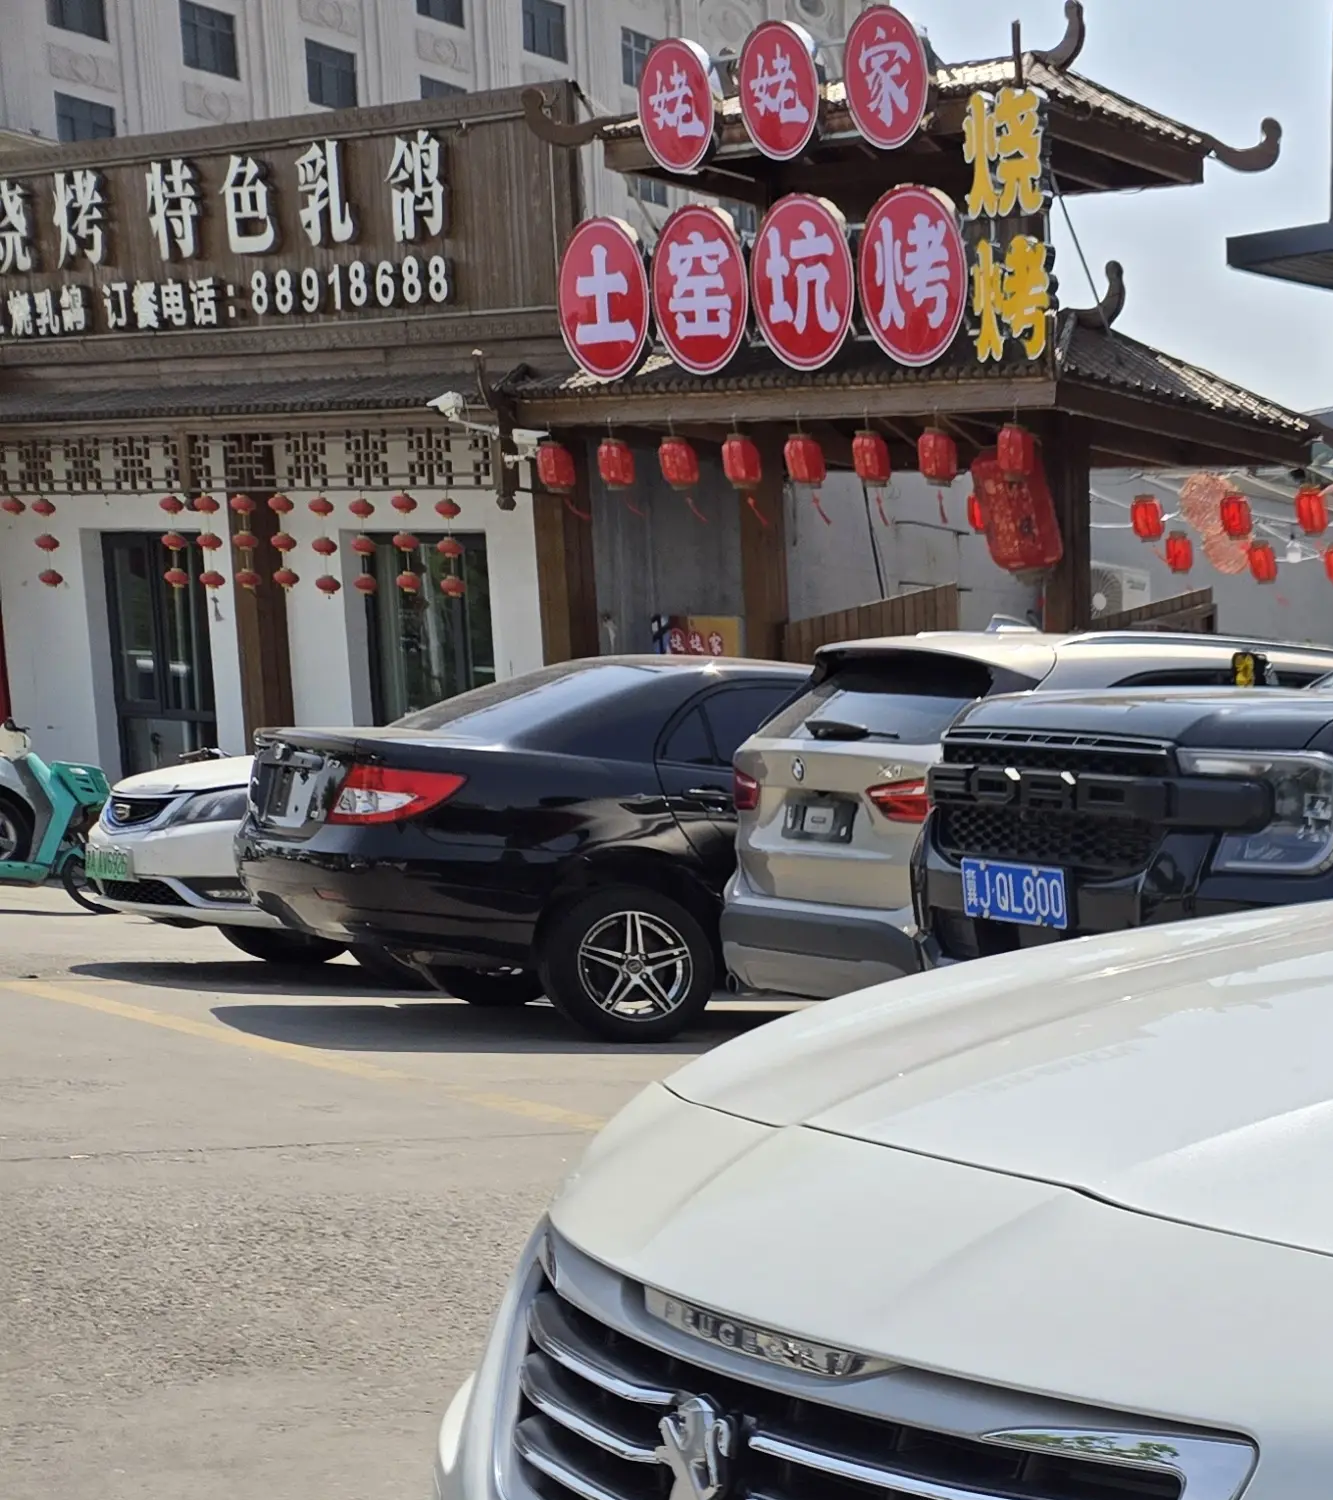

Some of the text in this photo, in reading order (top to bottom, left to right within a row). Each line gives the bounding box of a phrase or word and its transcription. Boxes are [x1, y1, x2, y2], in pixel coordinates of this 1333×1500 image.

[648, 27, 912, 139] 姥姥家
[145, 130, 445, 260] 特色乳鸽
[964, 86, 1051, 363] 烧烤
[575, 212, 950, 346] 土窑坑烤
